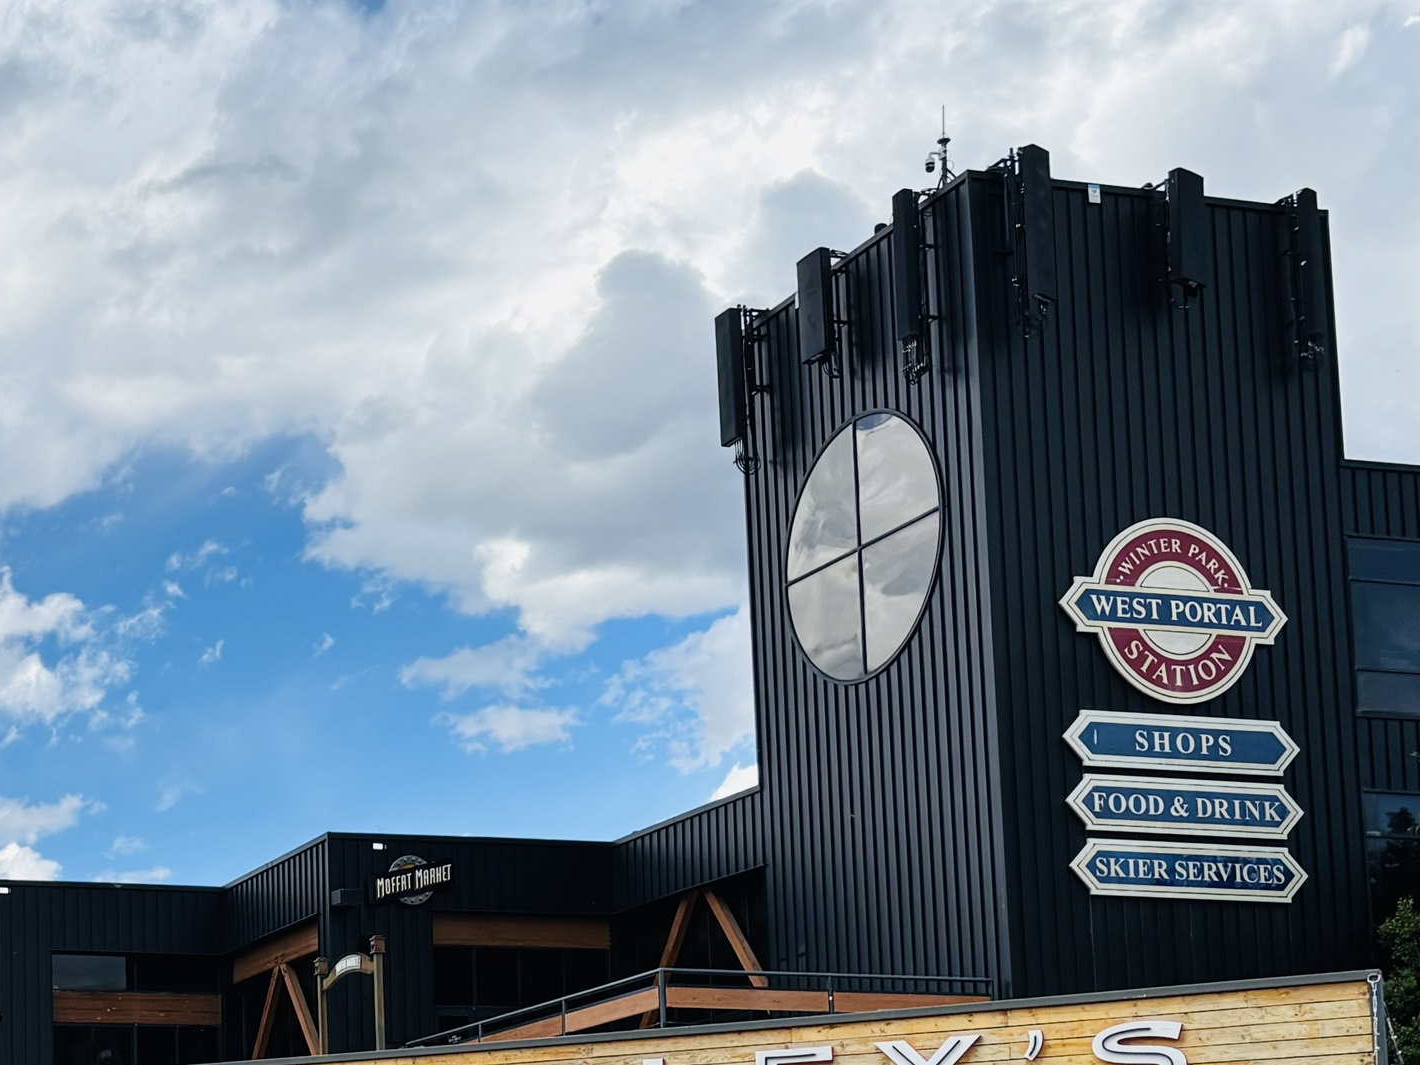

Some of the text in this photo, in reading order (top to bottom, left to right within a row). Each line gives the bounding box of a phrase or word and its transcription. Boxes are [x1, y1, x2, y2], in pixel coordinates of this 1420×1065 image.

[1118, 538, 1228, 585] WINTER PARK
[1090, 594, 1263, 628] WEST PORTAL
[1124, 639, 1234, 686] STATION
[1134, 730, 1232, 756] SHOPS
[1092, 792, 1282, 822] FOOD & DRINK
[376, 864, 452, 900] MOFFAT MARKET
[1095, 856, 1286, 885] SKIER SERVICES
